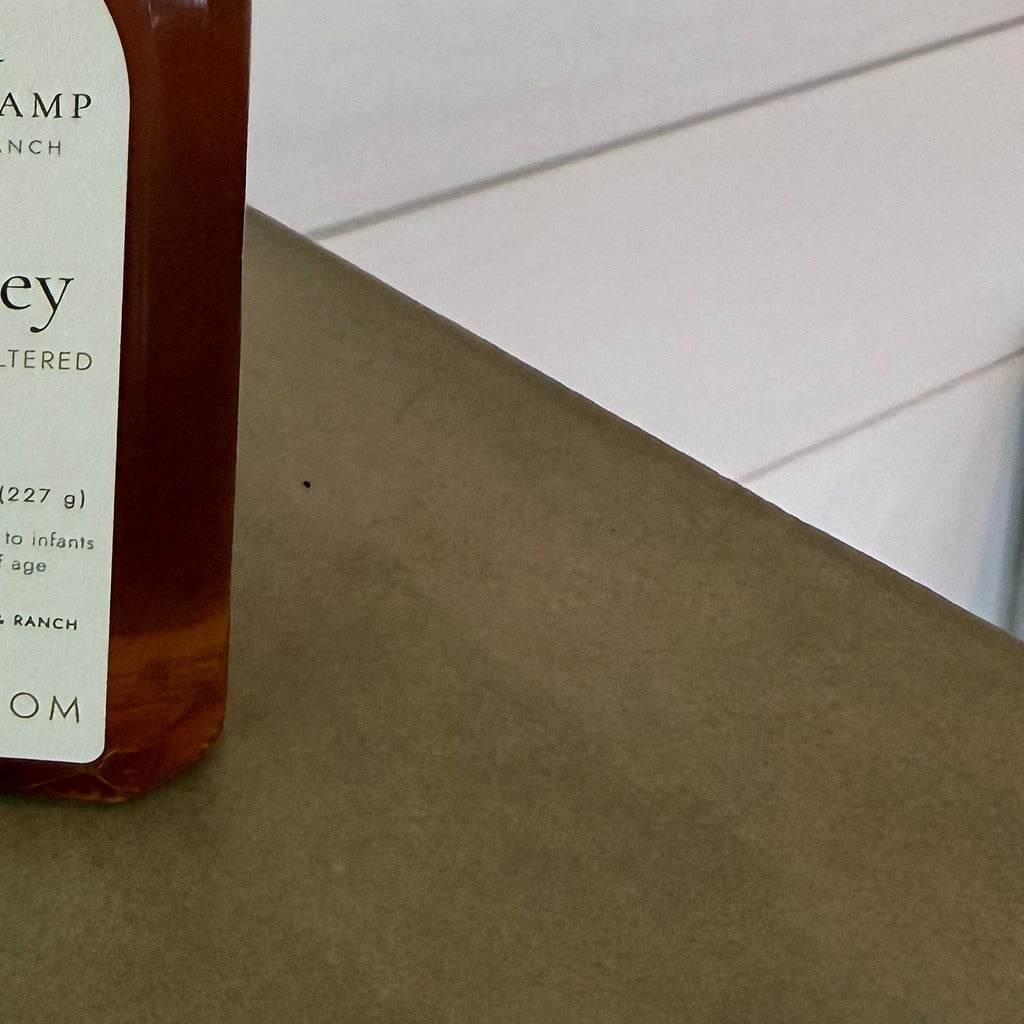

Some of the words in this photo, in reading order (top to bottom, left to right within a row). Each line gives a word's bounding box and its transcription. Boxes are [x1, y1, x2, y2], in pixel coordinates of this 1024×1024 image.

[63, 488, 86, 510] g)
[5, 531, 23, 547] to
[32, 532, 95, 551] infants
[11, 559, 48, 576] age
[13, 614, 78, 631] RANCH
